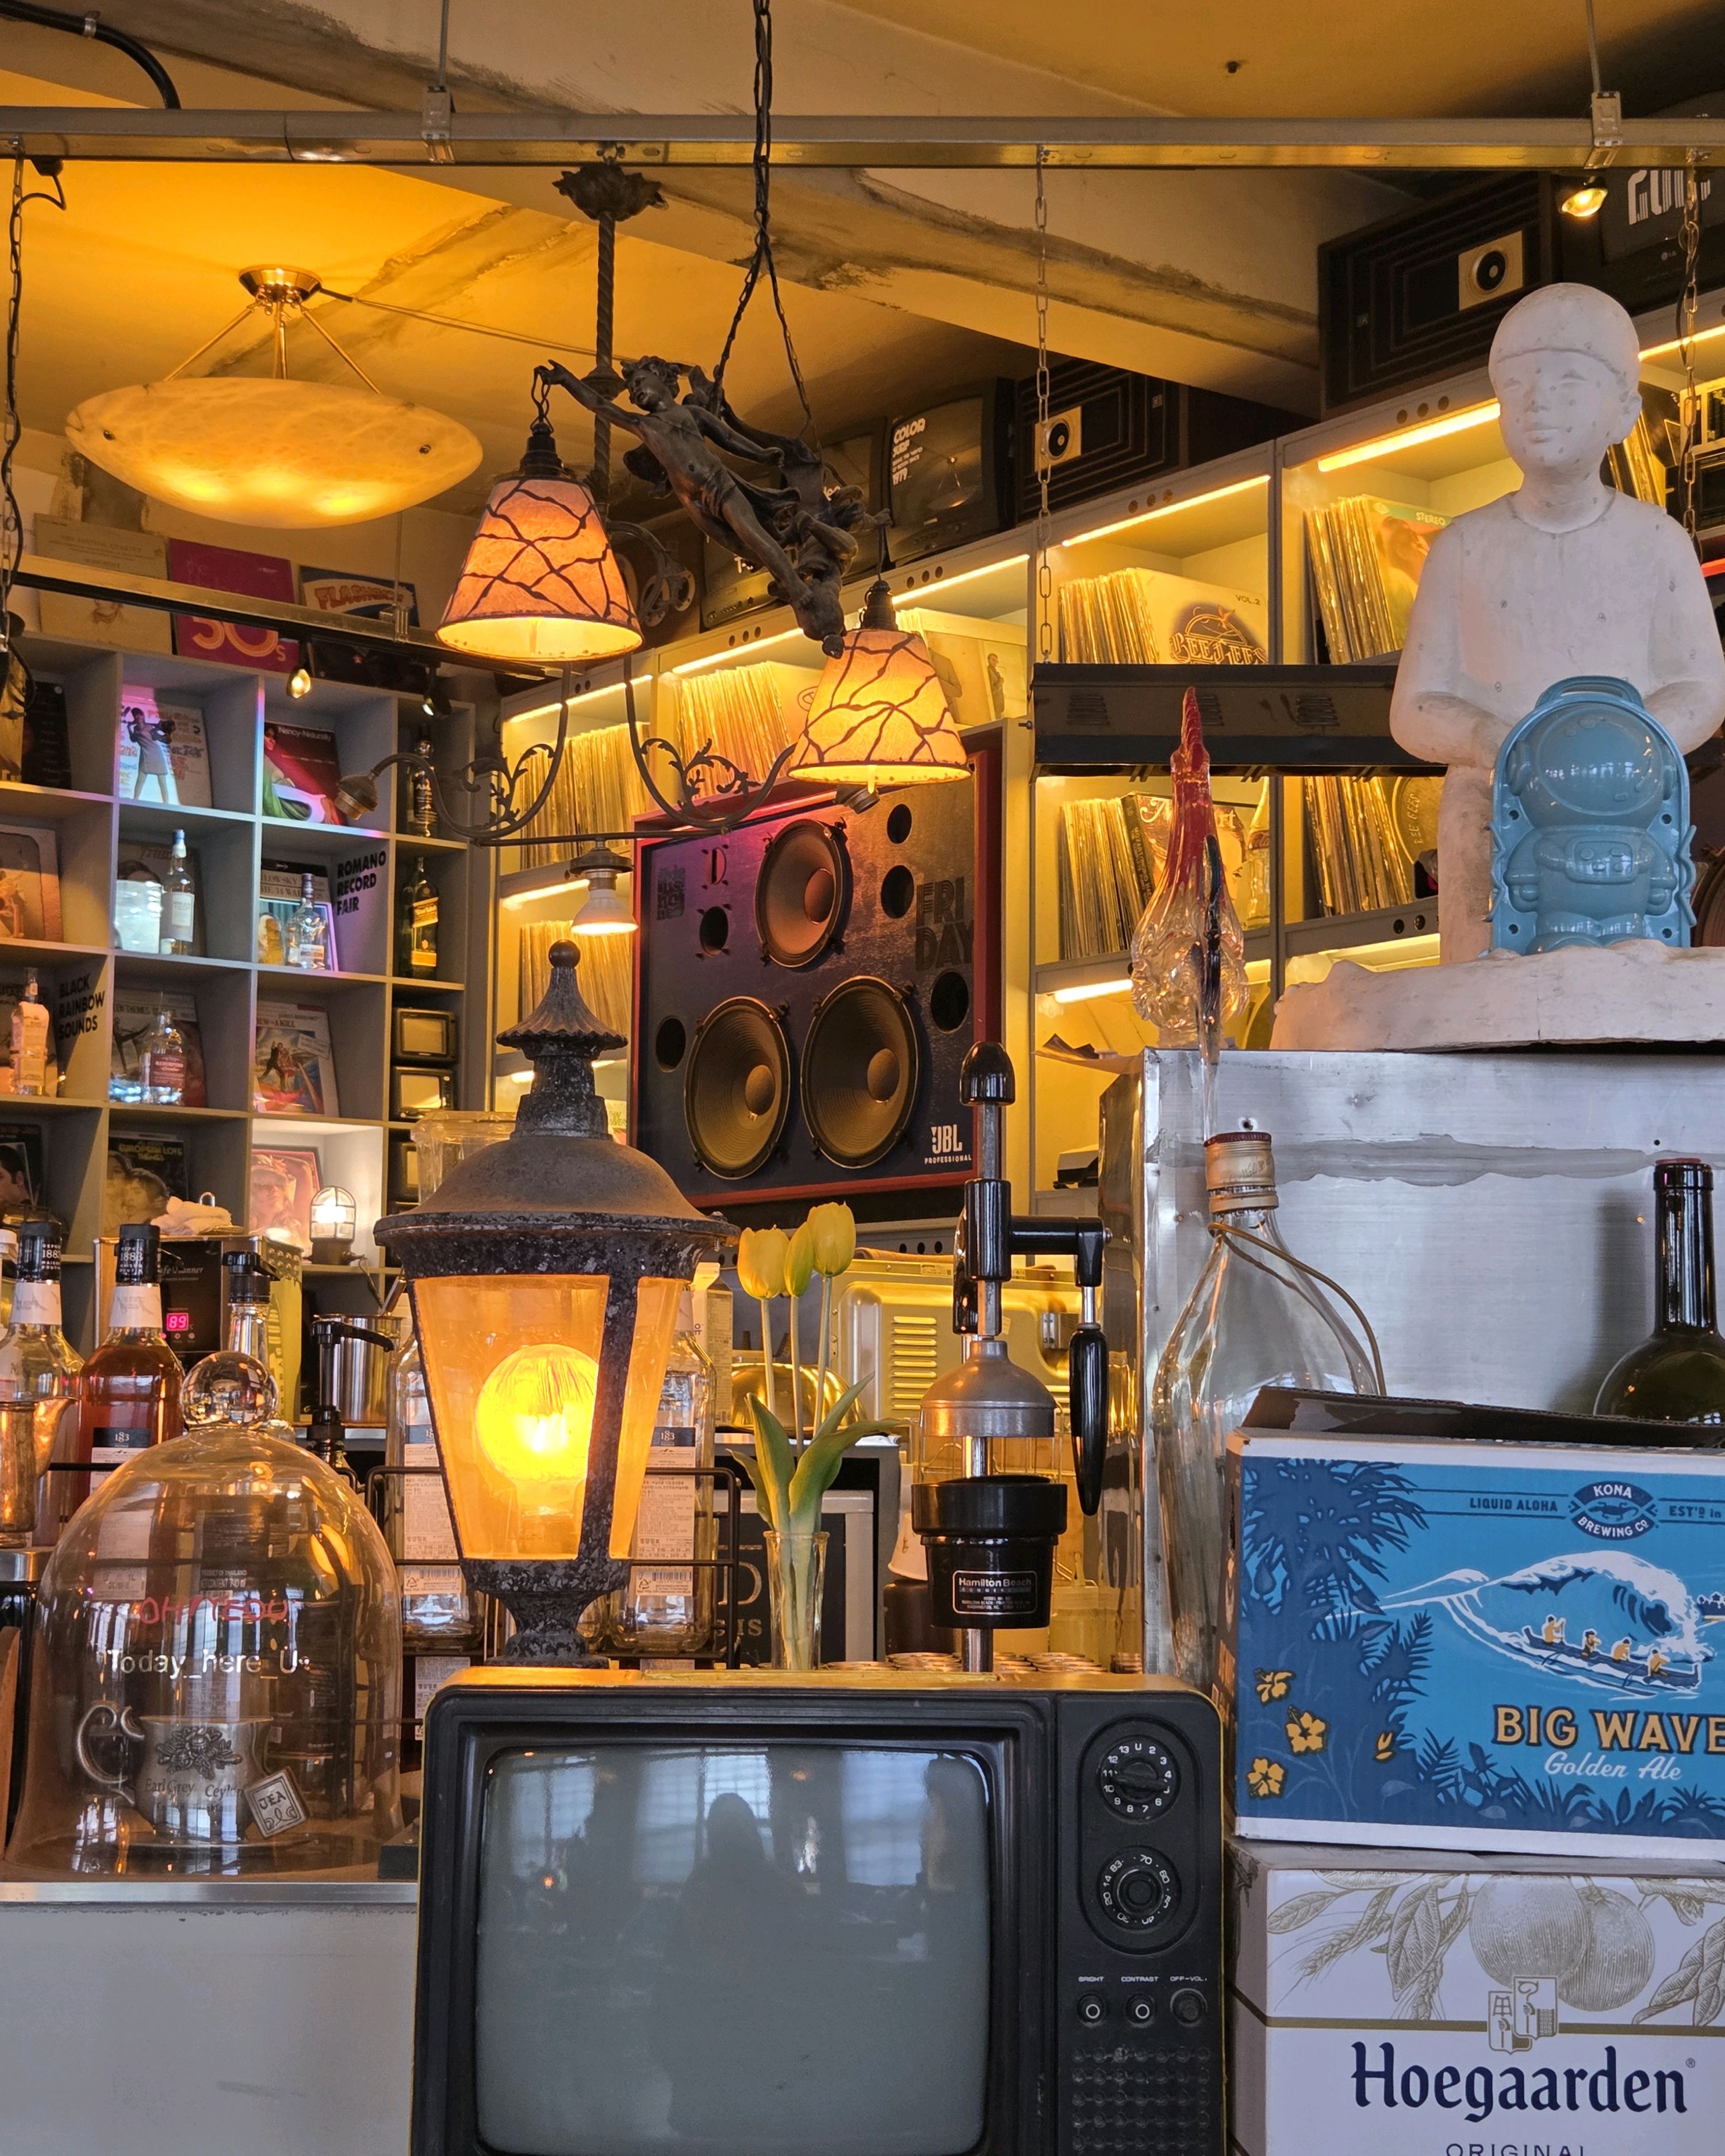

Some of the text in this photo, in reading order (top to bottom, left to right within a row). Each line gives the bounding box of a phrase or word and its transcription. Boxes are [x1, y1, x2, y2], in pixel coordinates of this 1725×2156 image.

[1416, 512, 1446, 526] STEREO
[337, 850, 386, 878] ROMANO
[336, 873, 377, 897] RECORD
[336, 896, 360, 916] FAIR
[59, 975, 90, 999] BLACK
[59, 991, 105, 1019] RAINBOW
[59, 1015, 98, 1041] SOUNDS
[931, 1123, 963, 1154] JBL
[924, 1154, 972, 1165] PROFESSIONAL
[120, 1252, 143, 1262] 1883
[168, 1315, 187, 1329] 89
[661, 1430, 675, 1441] 1883
[1593, 1483, 1632, 1499] KONA
[1470, 1497, 1558, 1513] LIQUID ALOHA
[1710, 1510, 1722, 1518] in
[1577, 1516, 1633, 1537] BREWING
[959, 1577, 1032, 1587] Hamilton Beach
[1492, 1704, 1725, 1755] BIG WAVE
[1118, 1745, 1129, 1754] 13
[1134, 1743, 1142, 1751] U
[1149, 1745, 1156, 1754] 2
[1107, 1755, 1118, 1763] 12
[1160, 1756, 1167, 1764] 3
[1544, 1751, 1683, 1781] Golden Ale
[1164, 1770, 1172, 1778] 4
[145, 1777, 194, 1796] Earl Grey
[205, 1784, 245, 1801] Ceylon
[1103, 1785, 1114, 1793] 10
[1114, 1797, 1121, 1805] 9
[1155, 1798, 1162, 1806] 6
[1127, 1805, 1134, 1813] 8
[1140, 1854, 1152, 1865] 70
[1103, 1875, 1112, 1887] 14
[1351, 2041, 1688, 2123] Hoegaarden
